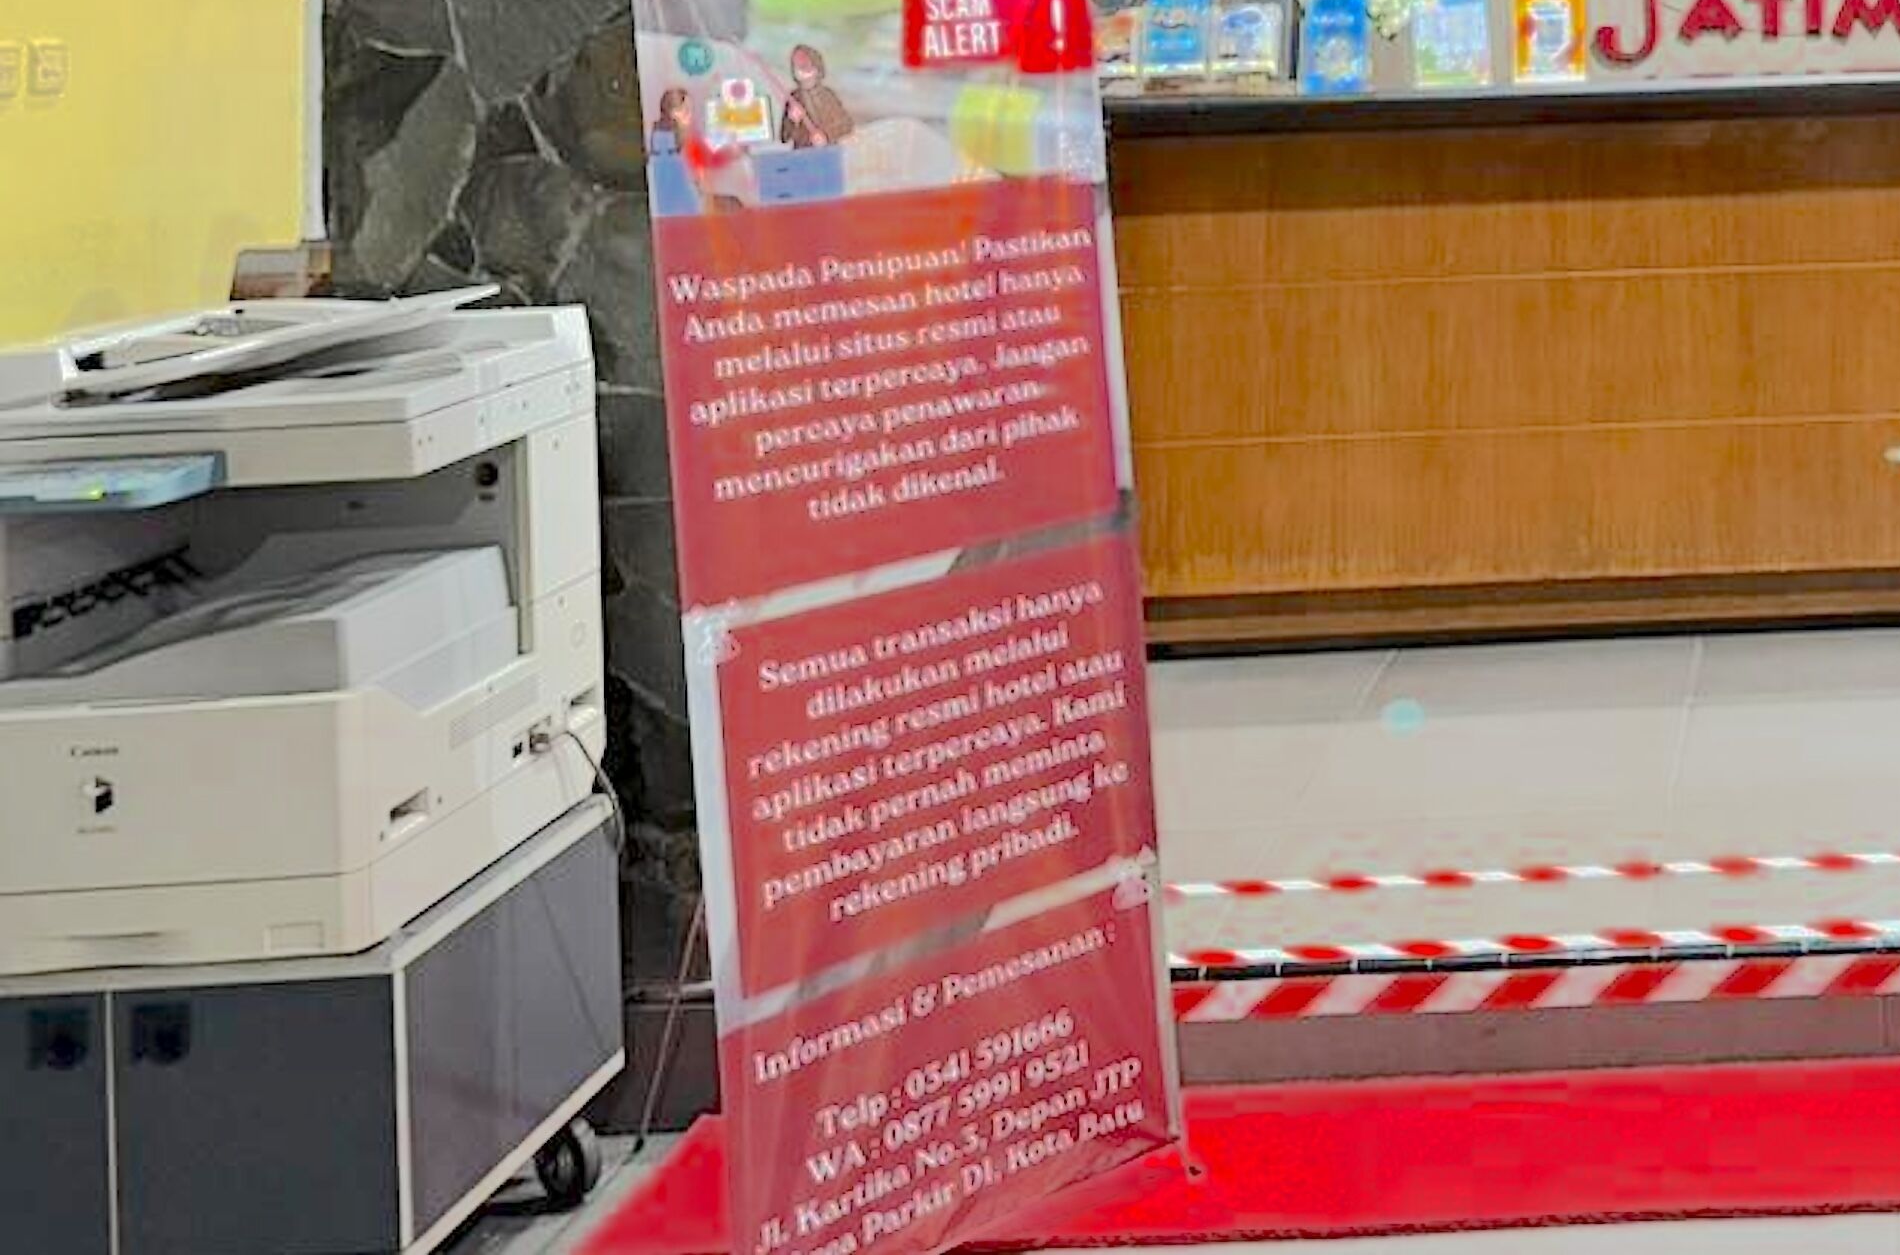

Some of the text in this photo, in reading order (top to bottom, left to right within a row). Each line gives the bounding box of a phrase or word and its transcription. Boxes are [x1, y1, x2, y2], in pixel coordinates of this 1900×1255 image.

[923, 20, 1001, 59] ALERT
[668, 265, 813, 304] Waspada
[974, 226, 1092, 261] Pastikan
[684, 264, 1085, 344] Anda memesan hotel hanya
[689, 336, 1090, 427] aplikasi terpercaya. Jangan
[714, 304, 1062, 379] melalui situs resmi atau
[713, 405, 1080, 501] mencurigakan dari pihak
[753, 411, 878, 457] percaya
[807, 455, 1004, 520] tidak dikenal.
[758, 580, 1104, 691] Semua transaksi hanya
[805, 623, 1070, 720] dilakukan melalui
[747, 651, 1124, 780] rekening resmi hotel atau
[751, 680, 1127, 823] aplikasi terpercaya. Kami
[761, 758, 1129, 910] pembayaran langsung ke
[782, 728, 1106, 852] tidak pernah meminta
[827, 811, 1080, 923] rekening pribadi.
[753, 997, 908, 1085] Informasi
[911, 982, 937, 1018] &
[816, 1090, 888, 1138] Telp
[976, 1007, 1074, 1071] 591666
[795, 1160, 910, 1233] Kartika
[992, 1083, 1086, 1141] Depan
[1090, 1057, 1141, 1102] JTP
[806, 1140, 864, 1186] WA
[883, 1096, 951, 1149] 0877
[957, 1063, 1020, 1117] 5991
[1026, 1042, 1090, 1086] 9521
[862, 1182, 957, 1245] Parkir
[1006, 1128, 1073, 1174] Kota
[1078, 1099, 1145, 1142] Batu
